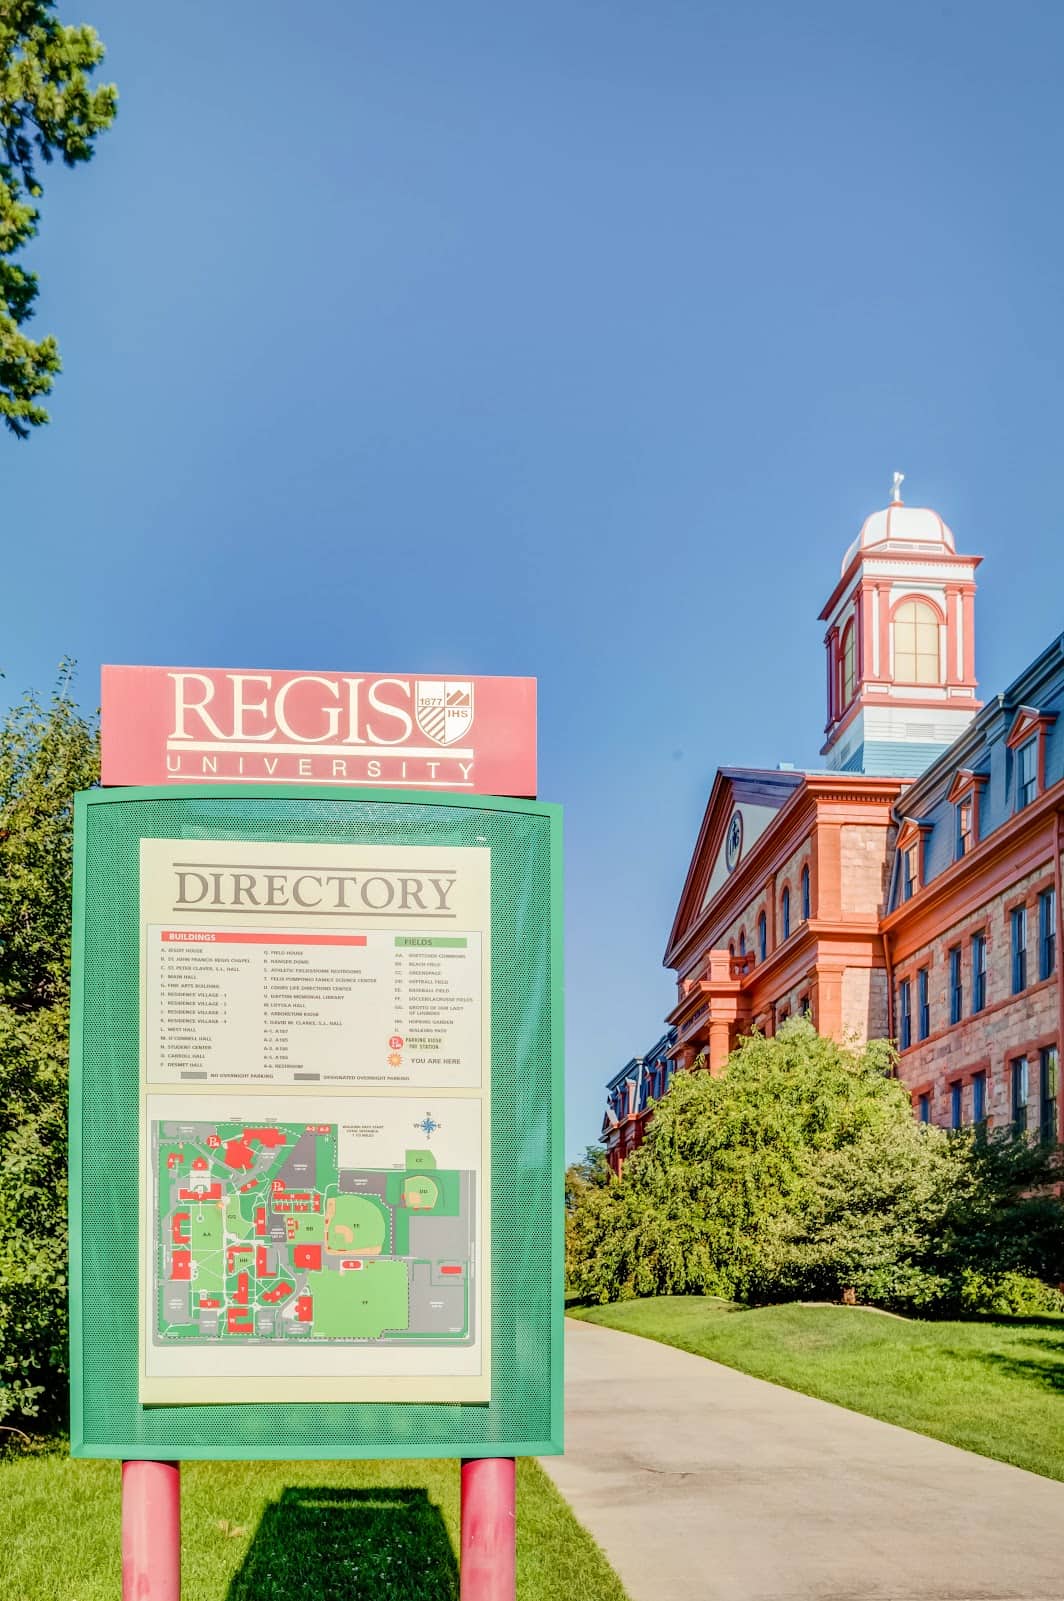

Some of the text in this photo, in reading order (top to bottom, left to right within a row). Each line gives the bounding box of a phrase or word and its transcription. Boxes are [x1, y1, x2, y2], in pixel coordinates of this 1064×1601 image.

[167, 672, 412, 745] REGIS
[420, 698, 442, 706] 1877
[448, 710, 468, 718] IHS
[167, 754, 474, 780] UNIVERSITY
[175, 872, 457, 910] DIRECTORY
[169, 933, 216, 941] BUILDINGS
